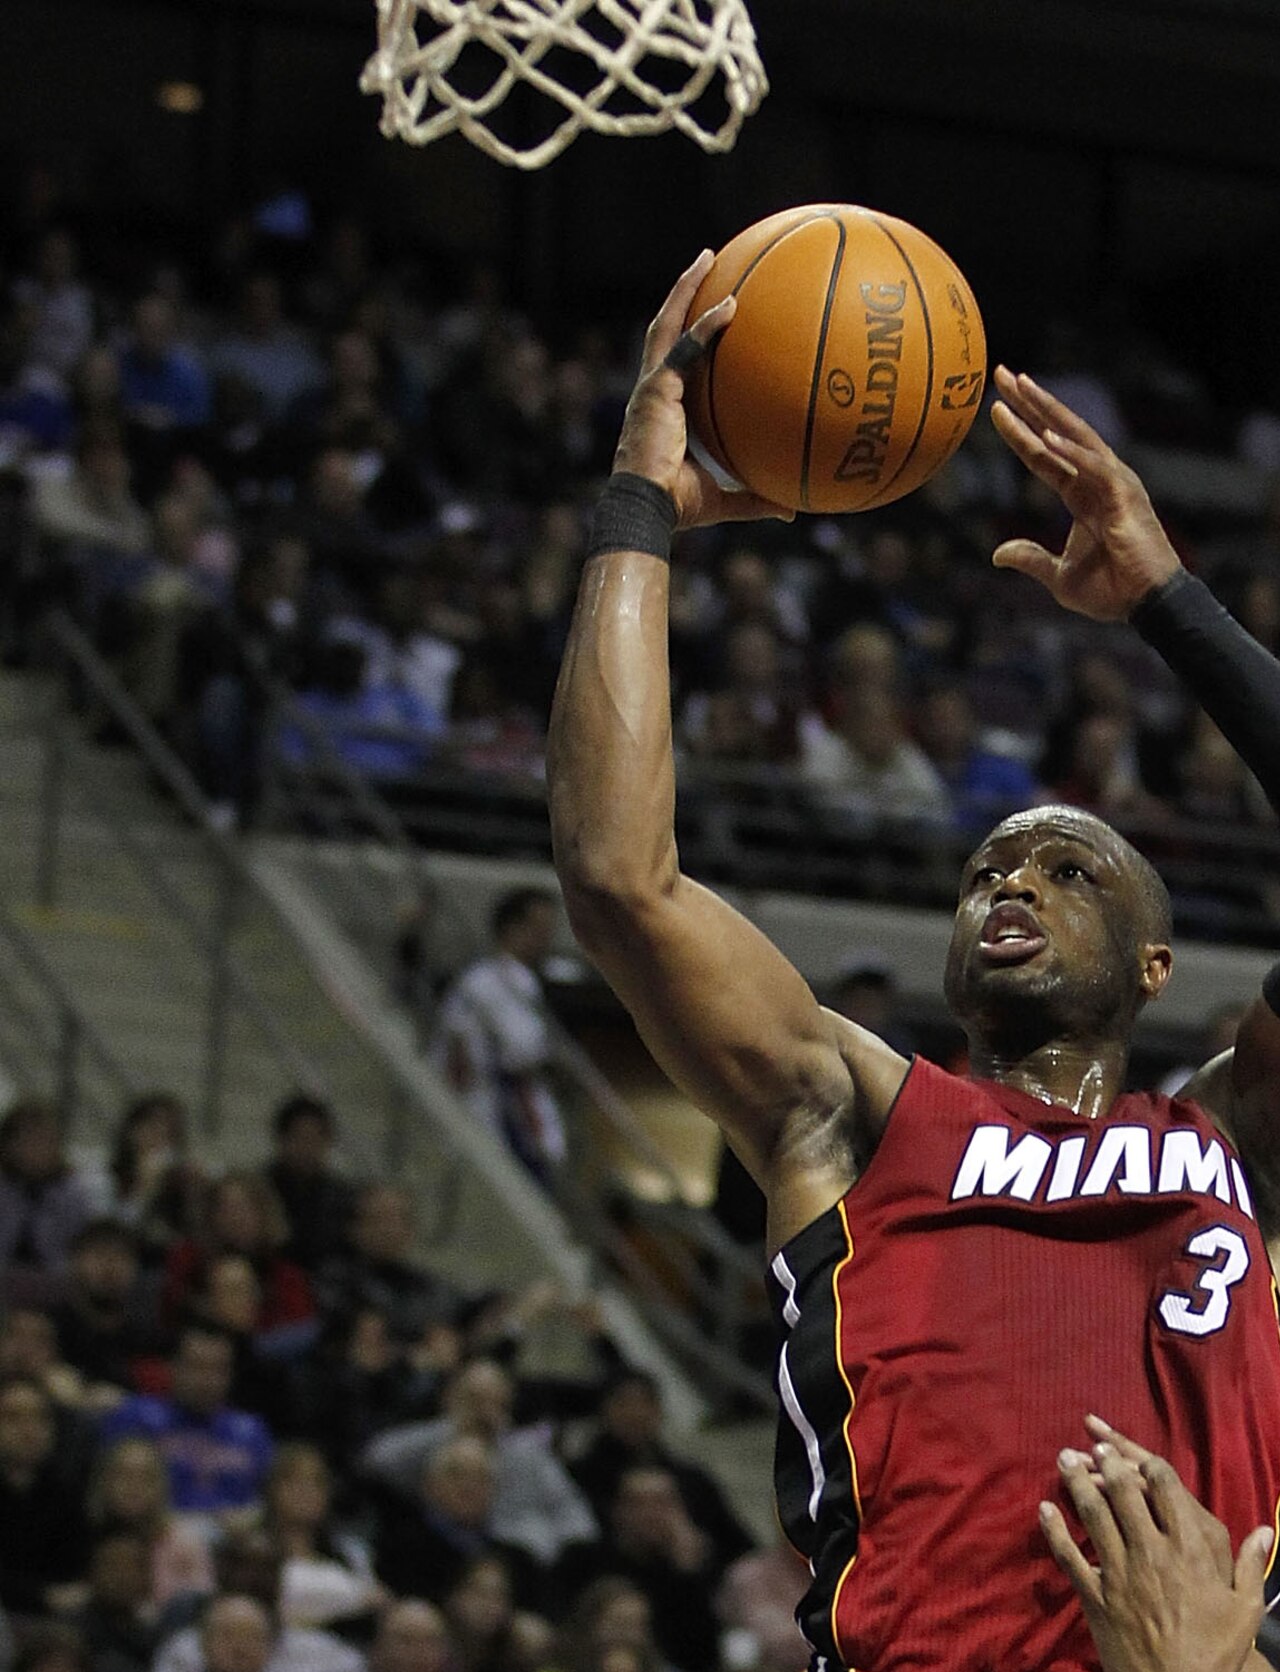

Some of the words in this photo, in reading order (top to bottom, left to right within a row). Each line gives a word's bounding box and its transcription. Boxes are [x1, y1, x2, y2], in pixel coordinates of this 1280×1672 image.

[833, 280, 907, 484] SPALDING
[950, 1124, 1255, 1220] MIAMI
[1157, 1224, 1251, 1338] 3
